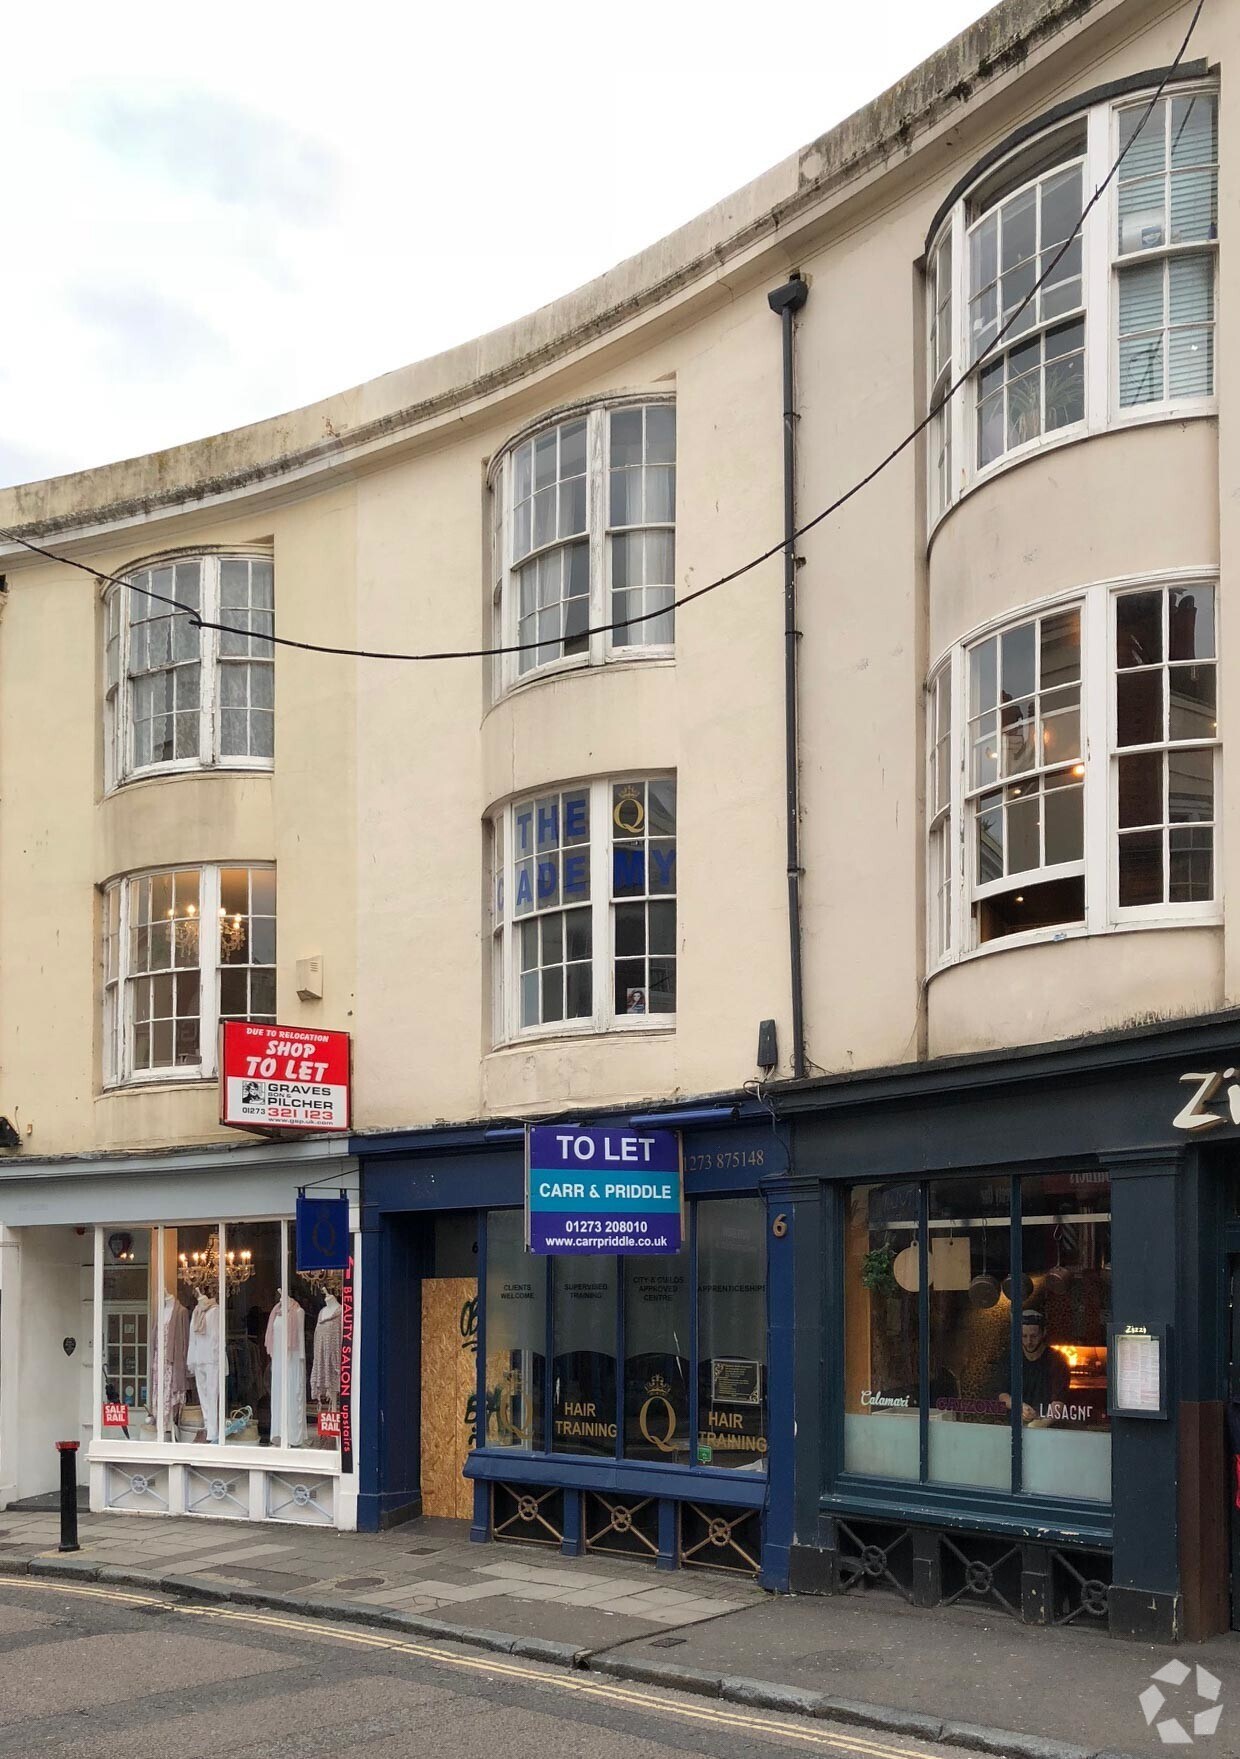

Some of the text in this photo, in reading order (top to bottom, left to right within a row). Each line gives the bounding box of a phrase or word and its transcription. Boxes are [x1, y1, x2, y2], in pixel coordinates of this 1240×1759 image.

[516, 798, 645, 849] THE Q
[246, 1027, 329, 1043] DUE TO RELOCATION
[266, 1040, 316, 1059] SHOP
[246, 1056, 329, 1082] TO LET
[268, 1083, 331, 1096] GRAVES
[267, 1097, 333, 1110] PILCHER
[242, 1107, 333, 1121] 01273 321 123
[556, 1135, 655, 1162] TO LET
[716, 1149, 764, 1169] 875148
[539, 1183, 671, 1200] CARR & PRIDDLE
[565, 1220, 648, 1233] 01273 208010
[772, 1213, 788, 1239] 6
[545, 1235, 668, 1249] www.carrpriddle.co.uk
[564, 1283, 608, 1291] SUPERVISED
[633, 1276, 649, 1284] CITY
[500, 1292, 535, 1300] WELCOME
[639, 1285, 678, 1293] APPROVED
[643, 1294, 673, 1302] CENTRE
[341, 1286, 353, 1453] BEAUTY SALON upstairs
[861, 1390, 910, 1407] Calamari
[105, 1405, 126, 1414] SALE
[564, 1402, 596, 1417] HAIR
[106, 1413, 125, 1422] RAIL
[320, 1413, 341, 1423] SALE
[639, 1396, 680, 1452] Q
[708, 1411, 743, 1429] HAIR
[321, 1422, 341, 1432] RAIL
[555, 1420, 618, 1438] TRAINING
[698, 1431, 768, 1453] TRAINING
